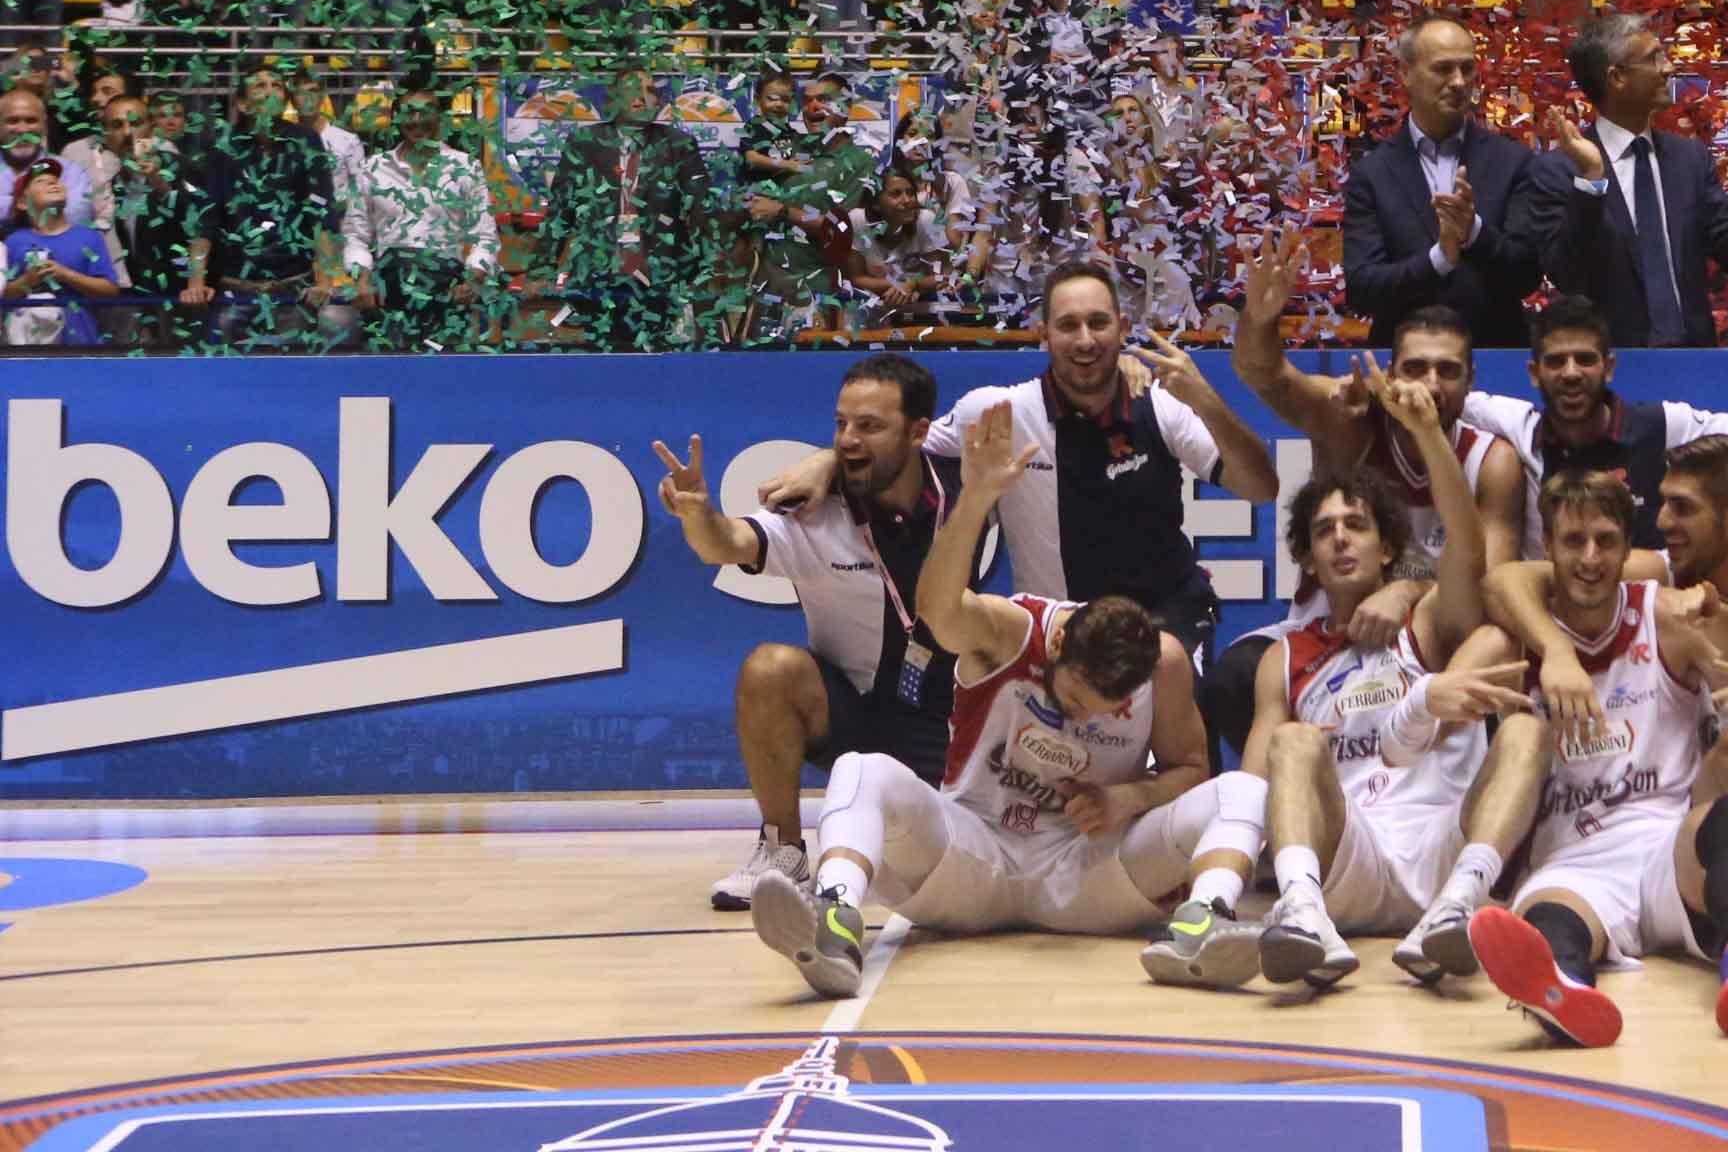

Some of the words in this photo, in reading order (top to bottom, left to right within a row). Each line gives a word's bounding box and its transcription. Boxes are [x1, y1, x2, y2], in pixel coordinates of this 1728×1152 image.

[6, 396, 644, 607] beko
[1360, 770, 1390, 808] 9
[1002, 801, 1039, 833] 18
